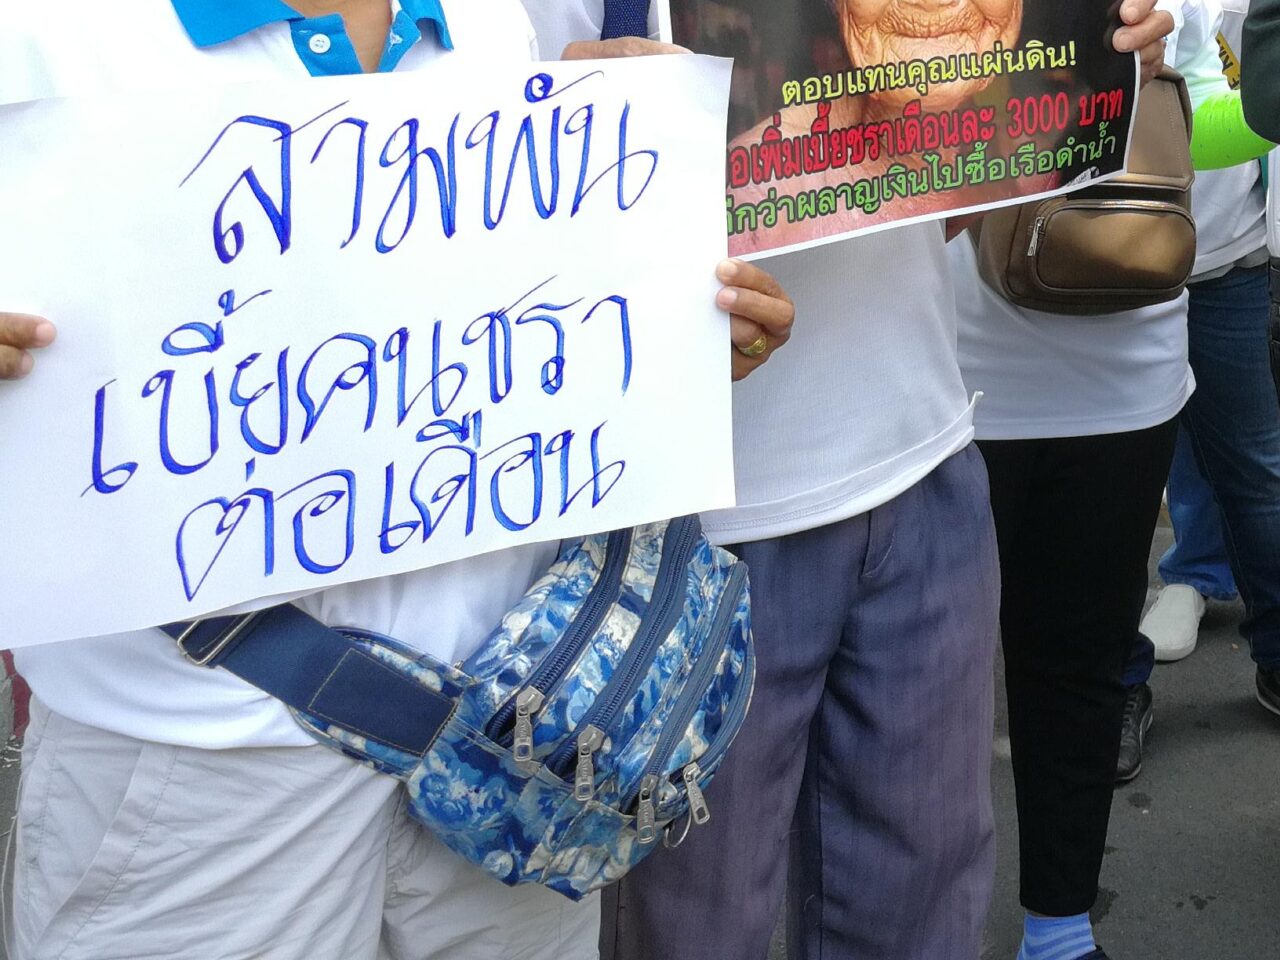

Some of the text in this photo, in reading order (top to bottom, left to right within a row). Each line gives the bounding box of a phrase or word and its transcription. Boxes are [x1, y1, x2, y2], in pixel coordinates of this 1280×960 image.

[179, 70, 659, 265] สามพัน
[727, 87, 1124, 188] อเพิ่มเบี้ยชราเดือนละ 3000 บาท
[781, 39, 1077, 106] ตอบแทนคุณแผ่นดิน!
[80, 274, 631, 499] เบี้ยคนชรา
[174, 409, 626, 603] ต่อเดือน
